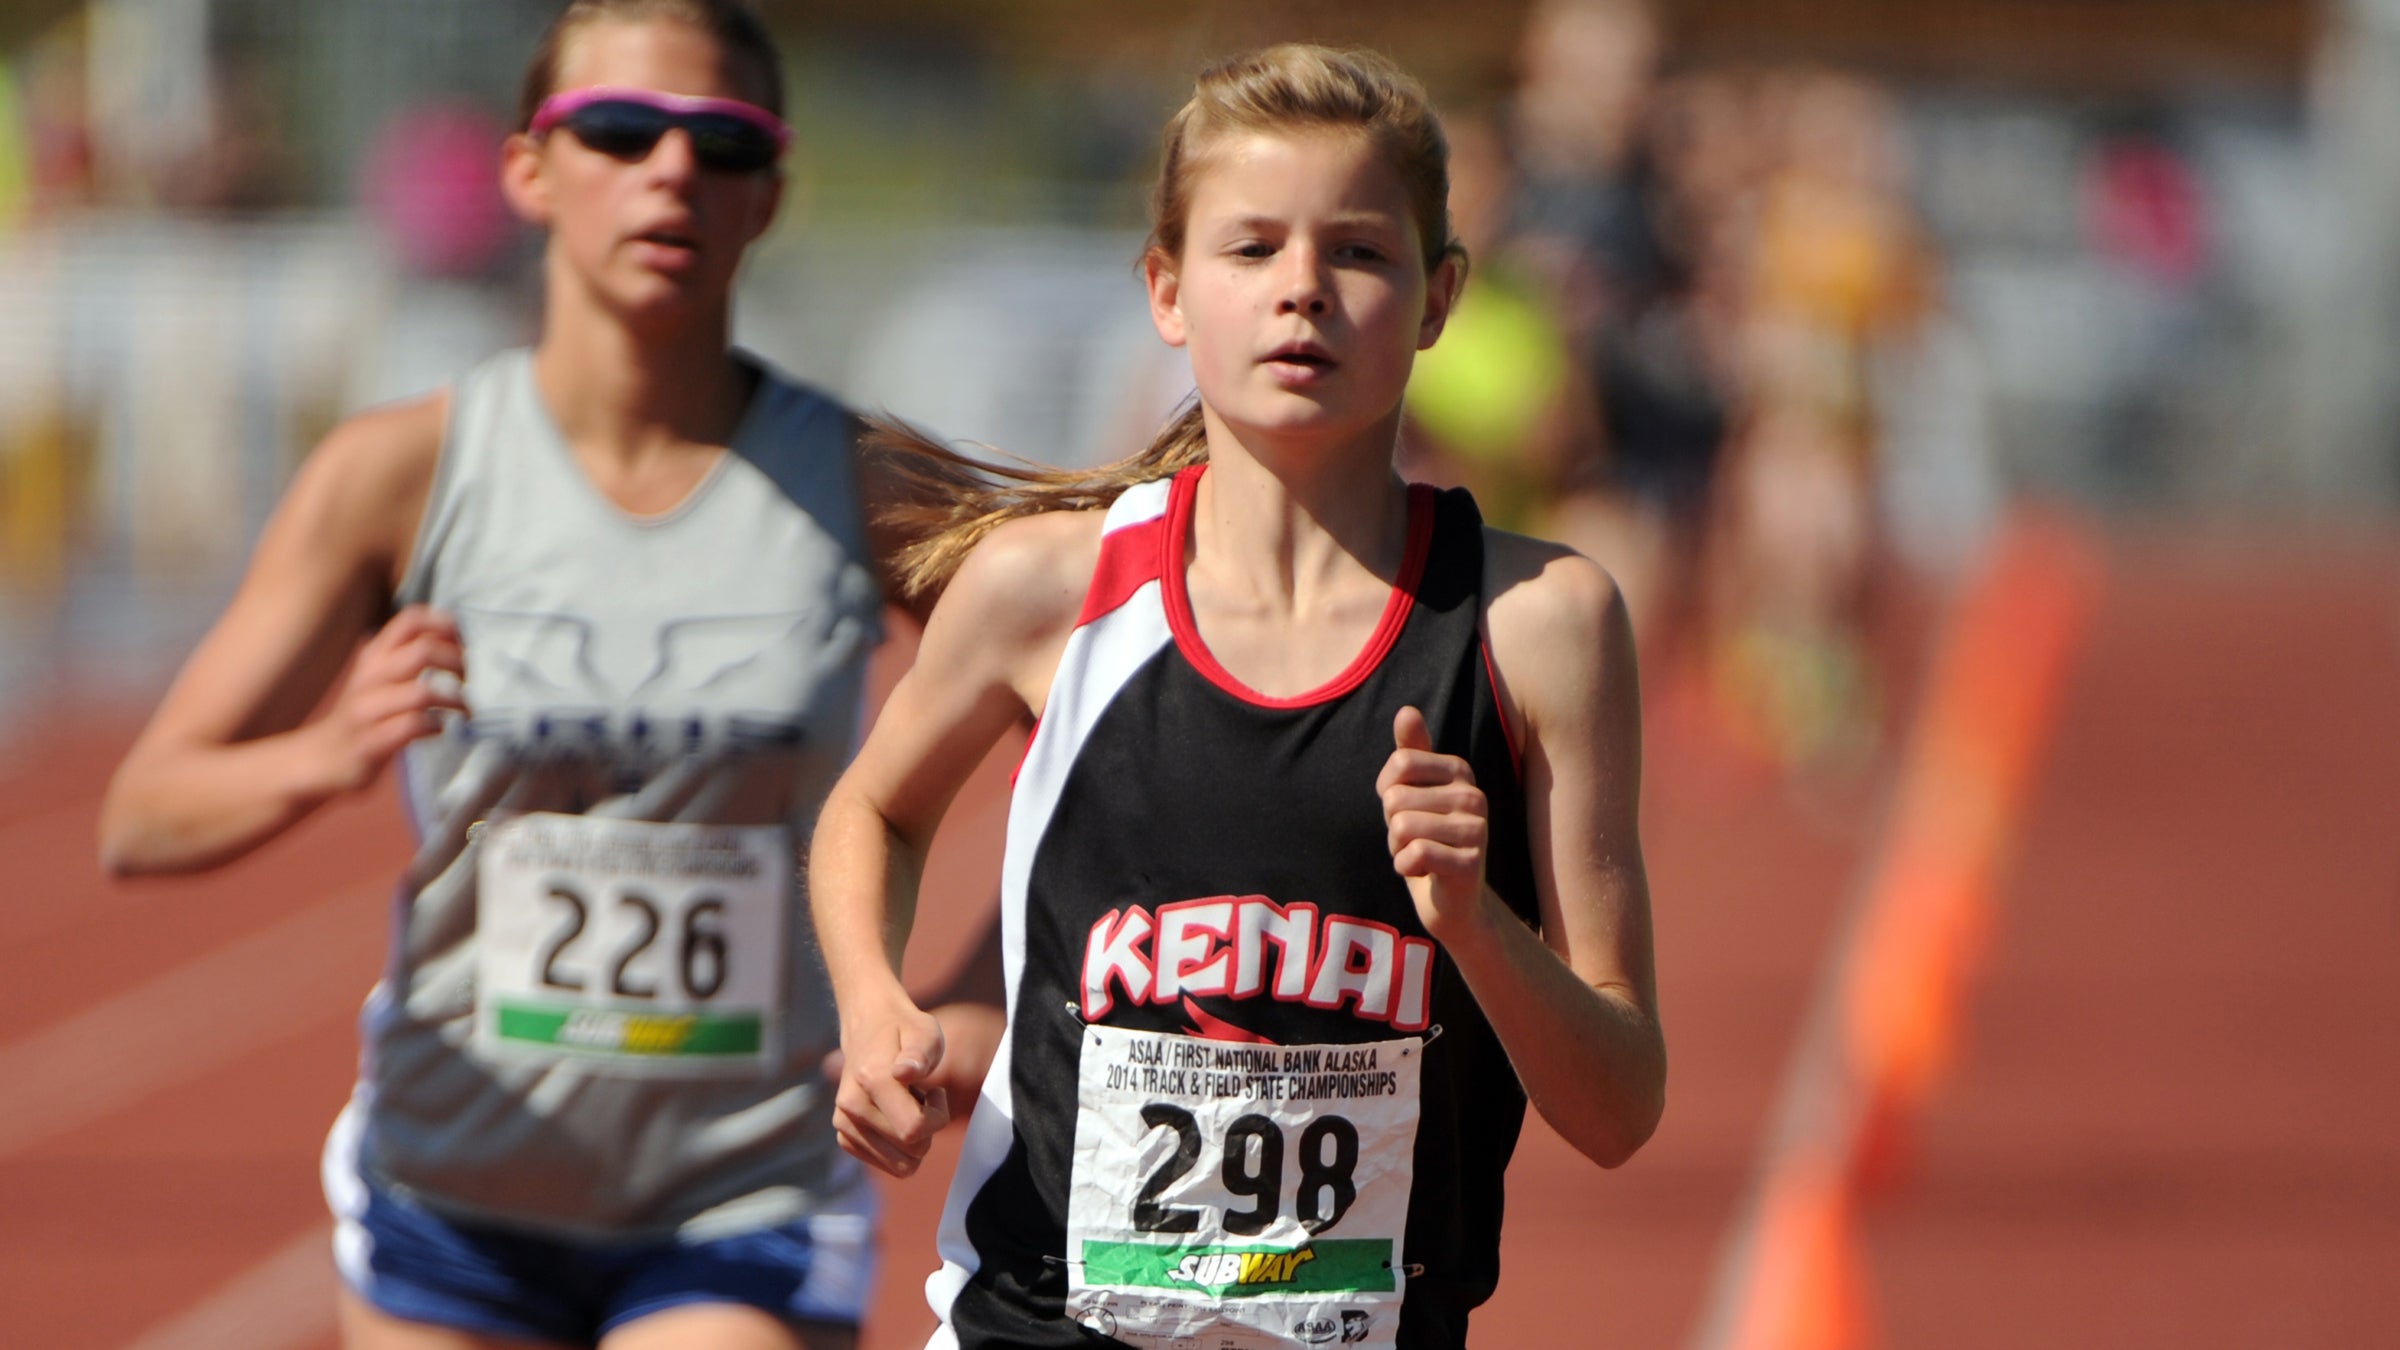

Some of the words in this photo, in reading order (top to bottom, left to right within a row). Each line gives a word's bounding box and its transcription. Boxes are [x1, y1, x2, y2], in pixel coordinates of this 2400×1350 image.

[541, 885, 728, 1001] 226
[1080, 895, 1435, 1031] KENAI
[1106, 1063, 1138, 1092] 2014
[1142, 1067, 1186, 1095] TRACK
[1190, 1071, 1200, 1095] &
[1204, 1071, 1241, 1098] FIELD
[1245, 1075, 1284, 1100] STATE
[1288, 1071, 1397, 1100] CHAMPIONSHIPS
[1215, 1047, 1279, 1073] NATIONAL
[1283, 1050, 1321, 1073] BANK
[1324, 1049, 1377, 1072] ALASKA
[1133, 1103, 1359, 1237] 298
[1166, 1248, 1316, 1287] SUBWAY
